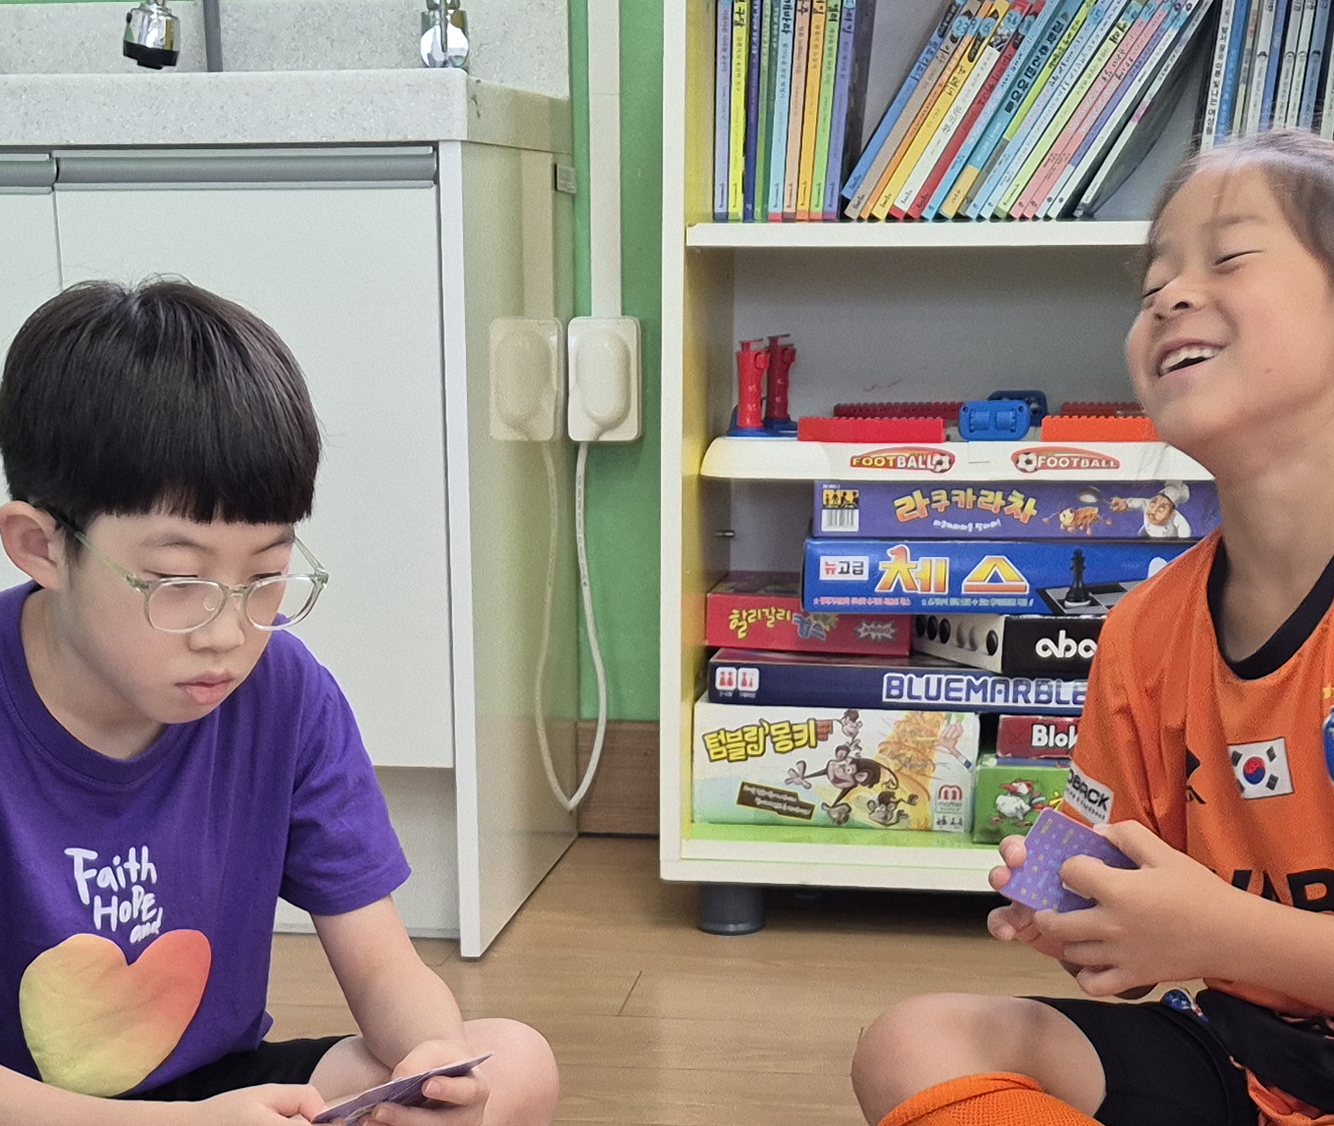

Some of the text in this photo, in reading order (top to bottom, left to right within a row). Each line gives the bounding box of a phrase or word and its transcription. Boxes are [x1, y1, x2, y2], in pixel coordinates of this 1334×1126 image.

[852, 455, 934, 470] FOOTBALL
[1036, 456, 1118, 470] FOOTBALL
[893, 487, 1038, 524] 라쿠카라차
[823, 560, 865, 577] 뉴고급
[728, 606, 792, 640] 할리갈리
[703, 718, 818, 762] 텀블링 몽키
[64, 845, 157, 905] Faith
